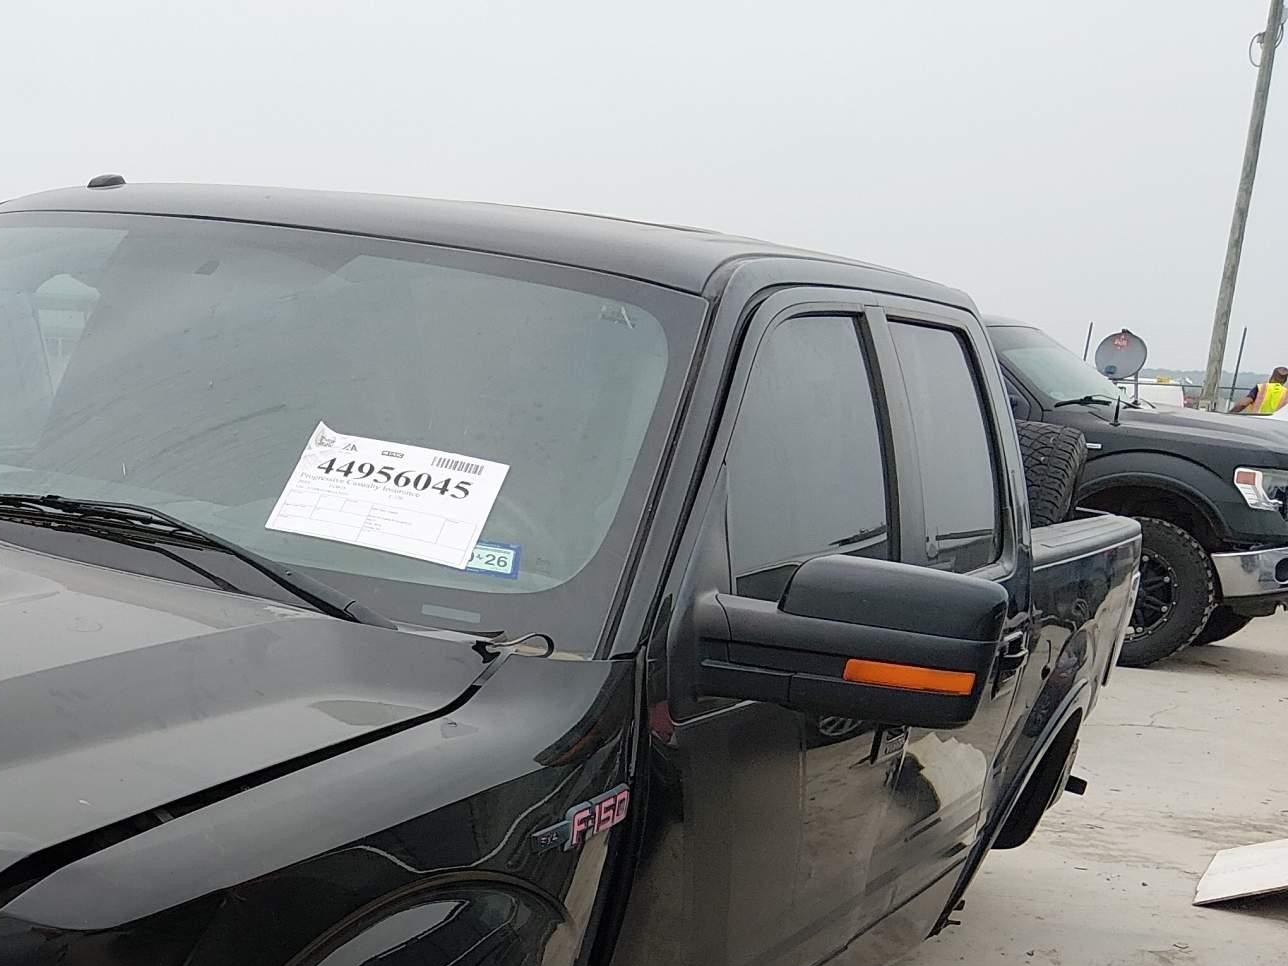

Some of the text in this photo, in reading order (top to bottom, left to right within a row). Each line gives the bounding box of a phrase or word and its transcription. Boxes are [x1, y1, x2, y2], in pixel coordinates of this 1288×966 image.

[317, 457, 472, 500] 44956045
[484, 553, 509, 568] 26
[572, 789, 630, 845] F-150
